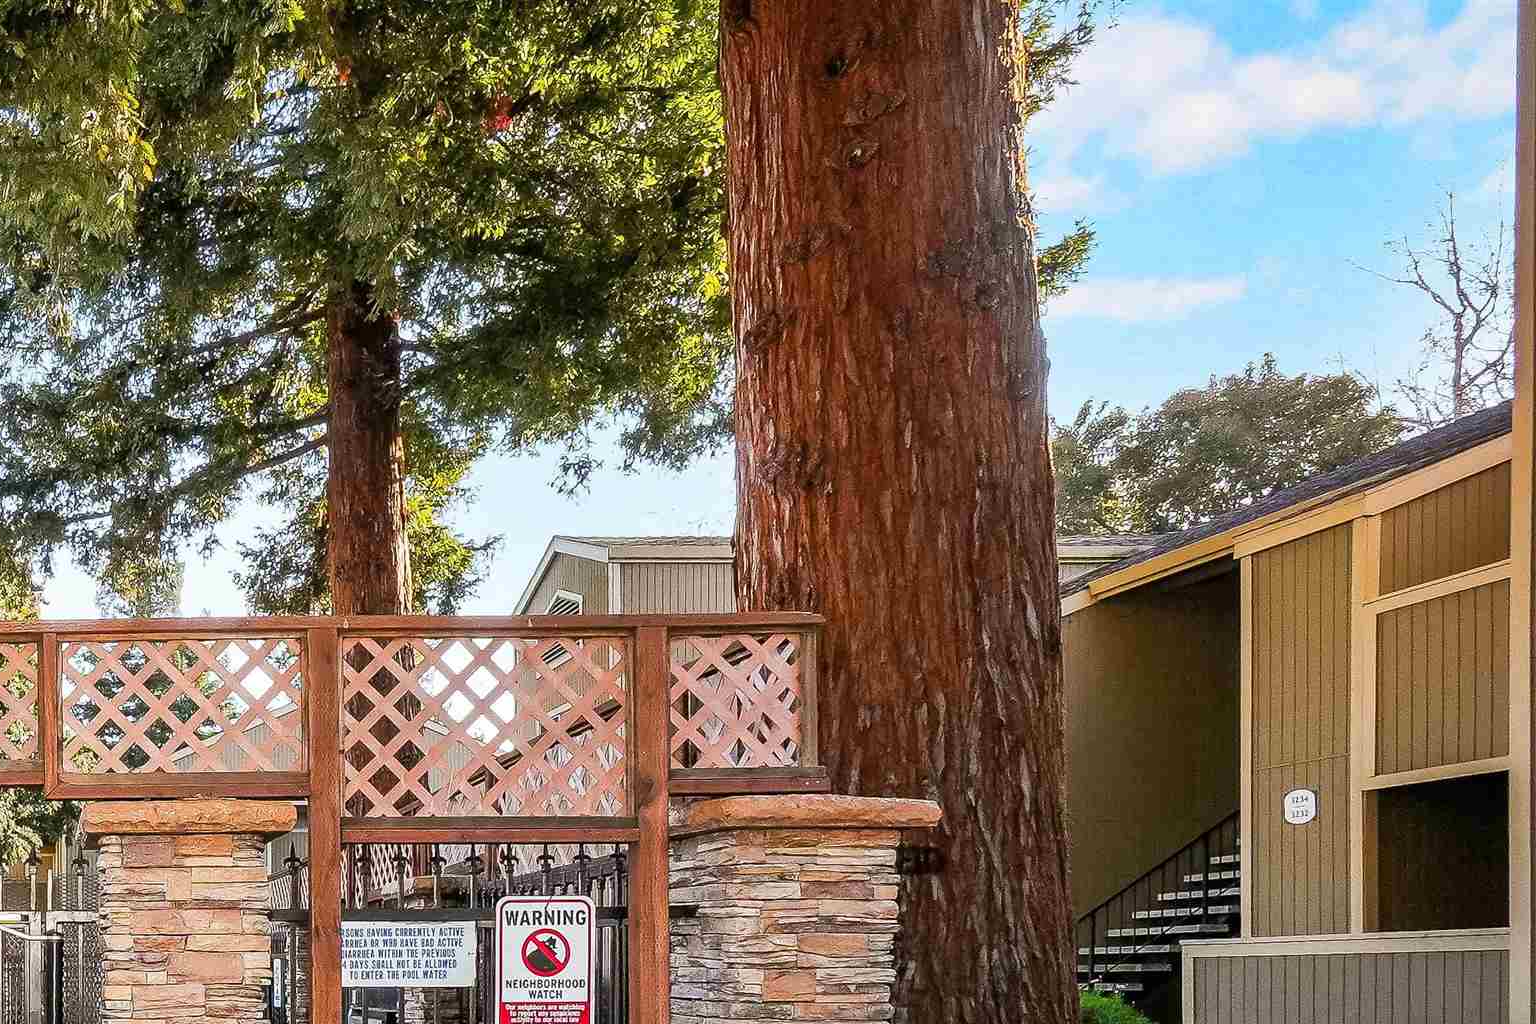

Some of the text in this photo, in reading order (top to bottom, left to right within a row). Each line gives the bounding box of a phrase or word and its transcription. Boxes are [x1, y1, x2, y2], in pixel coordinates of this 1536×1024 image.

[505, 910, 586, 926] WARNING
[366, 928, 393, 937] HAVING
[395, 928, 436, 937] CURRENTLY
[439, 927, 464, 937] ACTIVE
[370, 938, 380, 948] OR
[383, 938, 397, 948] WHO
[399, 938, 418, 948] HAVE
[421, 938, 434, 947] HAD
[437, 938, 464, 947] ACTIVE
[378, 949, 404, 958] WITHIN
[406, 949, 419, 958] THE
[421, 949, 456, 958] PREVIOUS
[370, 960, 393, 969] SHALL
[396, 960, 410, 969] NOT
[413, 960, 422, 968] BE
[424, 960, 457, 968] ALLOWED
[349, 970, 448, 980] TO ENTER THE POOL WATER
[505, 979, 586, 989] NEIGHBORHOOD
[528, 990, 563, 999] WATCH
